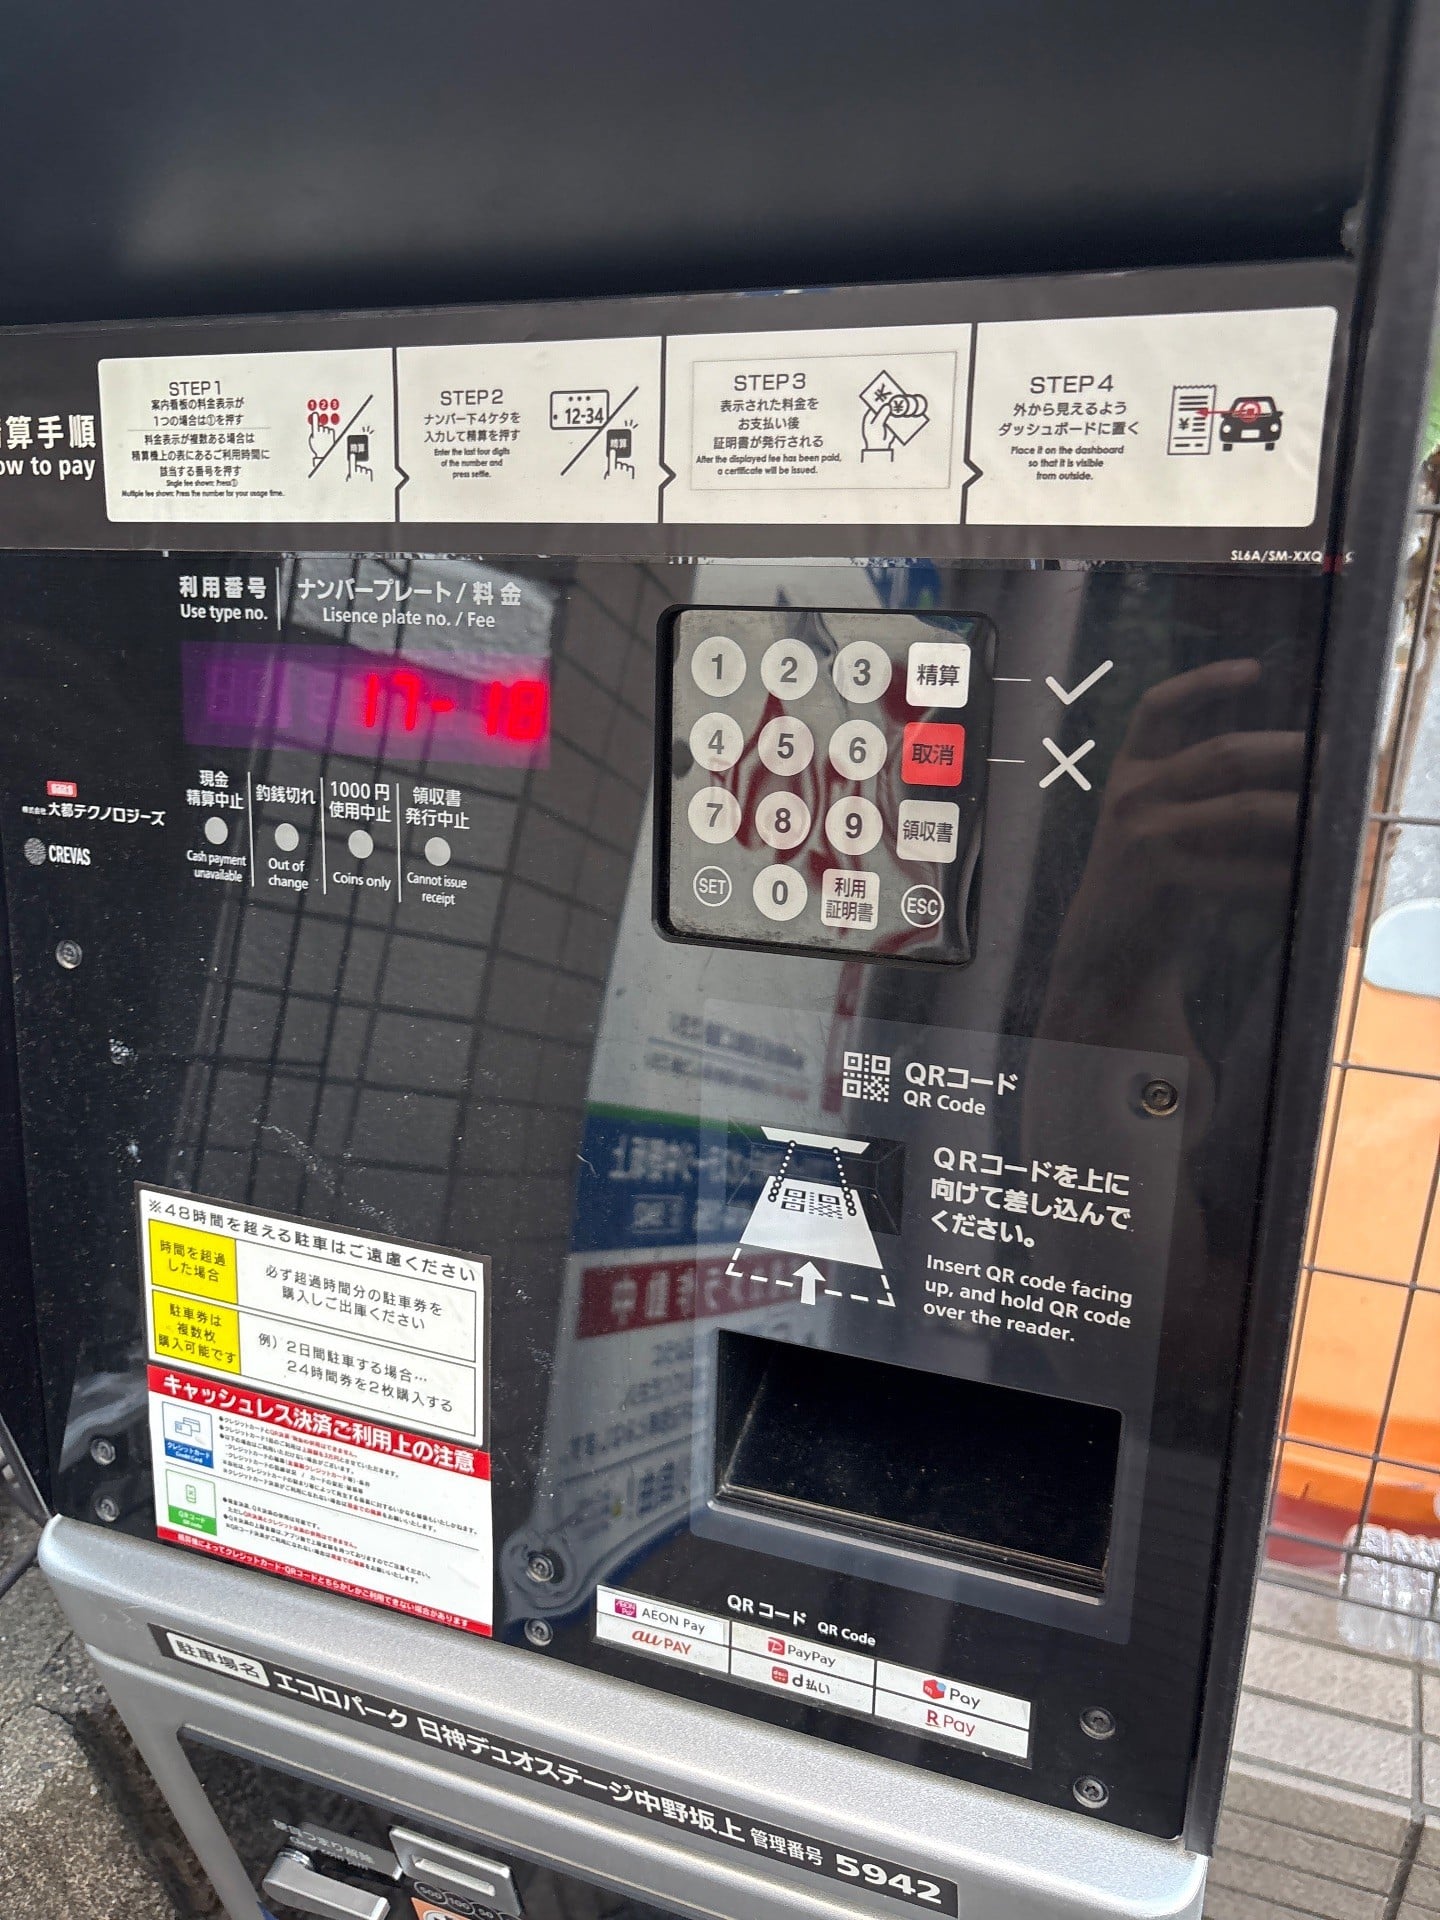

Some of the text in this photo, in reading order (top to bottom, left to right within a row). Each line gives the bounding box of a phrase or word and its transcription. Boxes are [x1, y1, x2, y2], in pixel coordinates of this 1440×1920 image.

[151, 397, 244, 410] 案内看板の料金表示が
[720, 398, 819, 412] 表示された料金を
[1013, 402, 1127, 417] 外から見えるよう
[424, 412, 521, 425] ナンバー下4ケタを
[565, 407, 604, 424] 12-34
[738, 417, 799, 431] お支払い後
[0, 415, 96, 449] 算手順
[144, 432, 255, 446] 料金表示が複数ある場合は
[424, 429, 521, 443] 入力して精算を押す
[998, 421, 1140, 436] ダッシュボードに置く
[713, 435, 824, 450] 証明書が発行される
[131, 449, 271, 462] 精算機上の表にあるご利用時間に
[30, 457, 96, 480] to pay
[160, 465, 242, 477] 該当する番号を押す
[179, 575, 268, 600] 利用番号
[297, 578, 522, 606] ナンバープレート 料金
[180, 603, 268, 623] Use type no.
[323, 607, 496, 628] Lisence plate no. Fee
[711, 654, 724, 679] 1
[781, 656, 798, 683] 2
[853, 659, 871, 686] 3
[917, 664, 961, 686] 精算
[708, 730, 725, 755] 4
[777, 733, 794, 760] 5
[849, 737, 866, 763] 6
[911, 743, 955, 766] 取消
[199, 769, 229, 788] 現金
[186, 789, 245, 810] 精算中止
[255, 784, 316, 805] 釣銭切れ
[412, 786, 462, 807] 領収書
[48, 801, 167, 826] 大都テクノロジーズ
[329, 801, 392, 823] 使用中止
[405, 807, 470, 830] 発行中止
[707, 802, 723, 827] 7
[774, 808, 791, 833] 8
[845, 812, 862, 839] 9
[902, 821, 953, 843] 領収書
[49, 844, 91, 866] CREVAS
[186, 850, 247, 869] Cash payment
[268, 857, 305, 872] Out of
[194, 868, 243, 882] unavailable
[268, 874, 309, 890] change
[333, 872, 392, 891] Coins only
[406, 872, 468, 890] Cannot issue
[699, 878, 727, 894] SET
[422, 891, 456, 907] receipt
[772, 881, 788, 906] 0
[834, 877, 866, 898] 利用
[826, 899, 874, 923] 証明書
[907, 898, 938, 916] ESC
[905, 1062, 1019, 1096] QRコード
[903, 1090, 986, 1116] QR Code
[933, 1147, 1130, 1196] QRコードを上に
[930, 1178, 1131, 1230] 向けて差し込んで
[931, 1210, 1036, 1248] ください。
[160, 1239, 226, 1267] 時間を超過
[168, 1258, 220, 1282] した場合
[927, 1254, 1133, 1308] Insert QR code facing
[264, 1264, 442, 1317] 必ず超過時間分の駐車券を
[282, 1286, 425, 1330] 購入しご出庫ください
[925, 1280, 1131, 1328] up, and hold QR code
[169, 1304, 222, 1328] 駐車券は
[924, 1302, 1075, 1342] over the reader.
[177, 1323, 216, 1344] 複数枚
[158, 1334, 236, 1364] 購入可能です
[287, 1360, 454, 1413] 24時間券を2枚購入する
[163, 1374, 475, 1473] キャッシュレス決済ご利用上の注意
[642, 1608, 705, 1634] AEON Pay
[727, 1594, 876, 1647] QR コード QR Code
[632, 1630, 692, 1655] au PAY
[788, 1644, 836, 1668] PayPay
[792, 1673, 830, 1694] d払い
[950, 1687, 981, 1710] Pay
[943, 1714, 976, 1737] Pay
[175, 1638, 942, 1905] 駐車場名 エコロパーク 日神デュオステージ中野坂上 管理番号 5942
